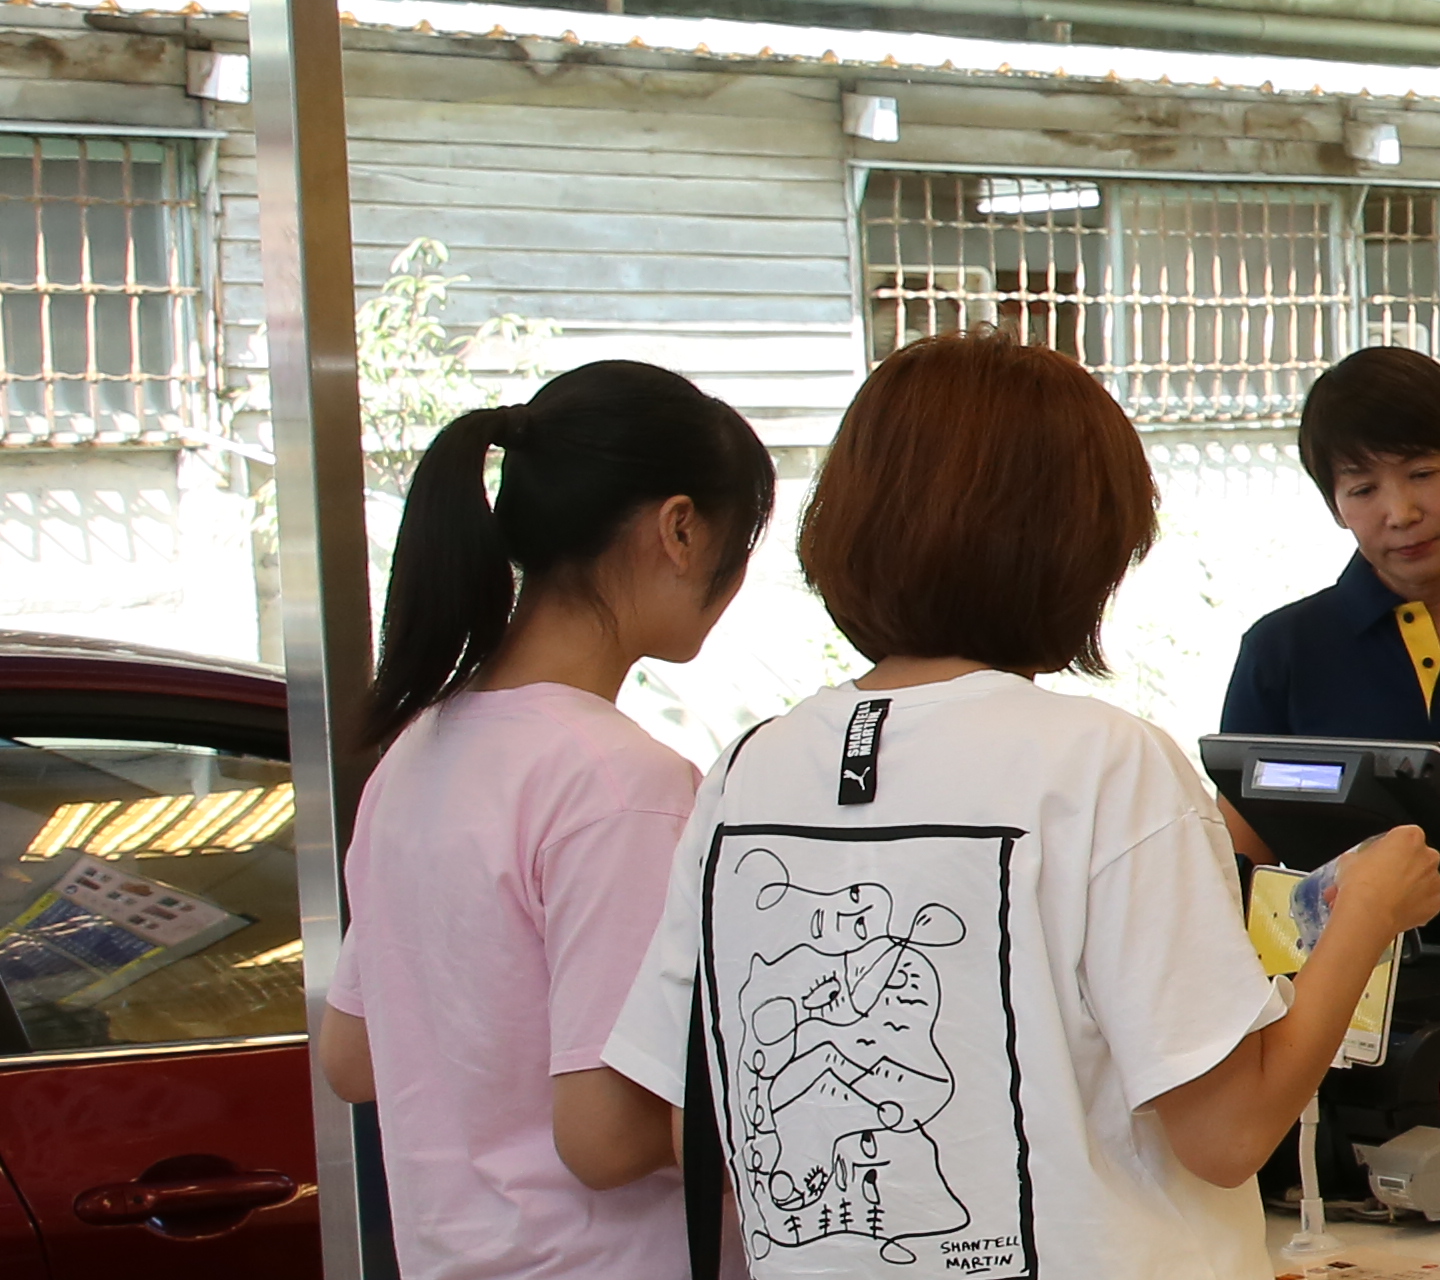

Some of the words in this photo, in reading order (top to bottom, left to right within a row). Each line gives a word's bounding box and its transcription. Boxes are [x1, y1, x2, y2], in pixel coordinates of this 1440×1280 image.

[847, 702, 871, 757] SHANTELL
[941, 1236, 1019, 1254] SHANTELL
[947, 1254, 1013, 1269] MARTIN
